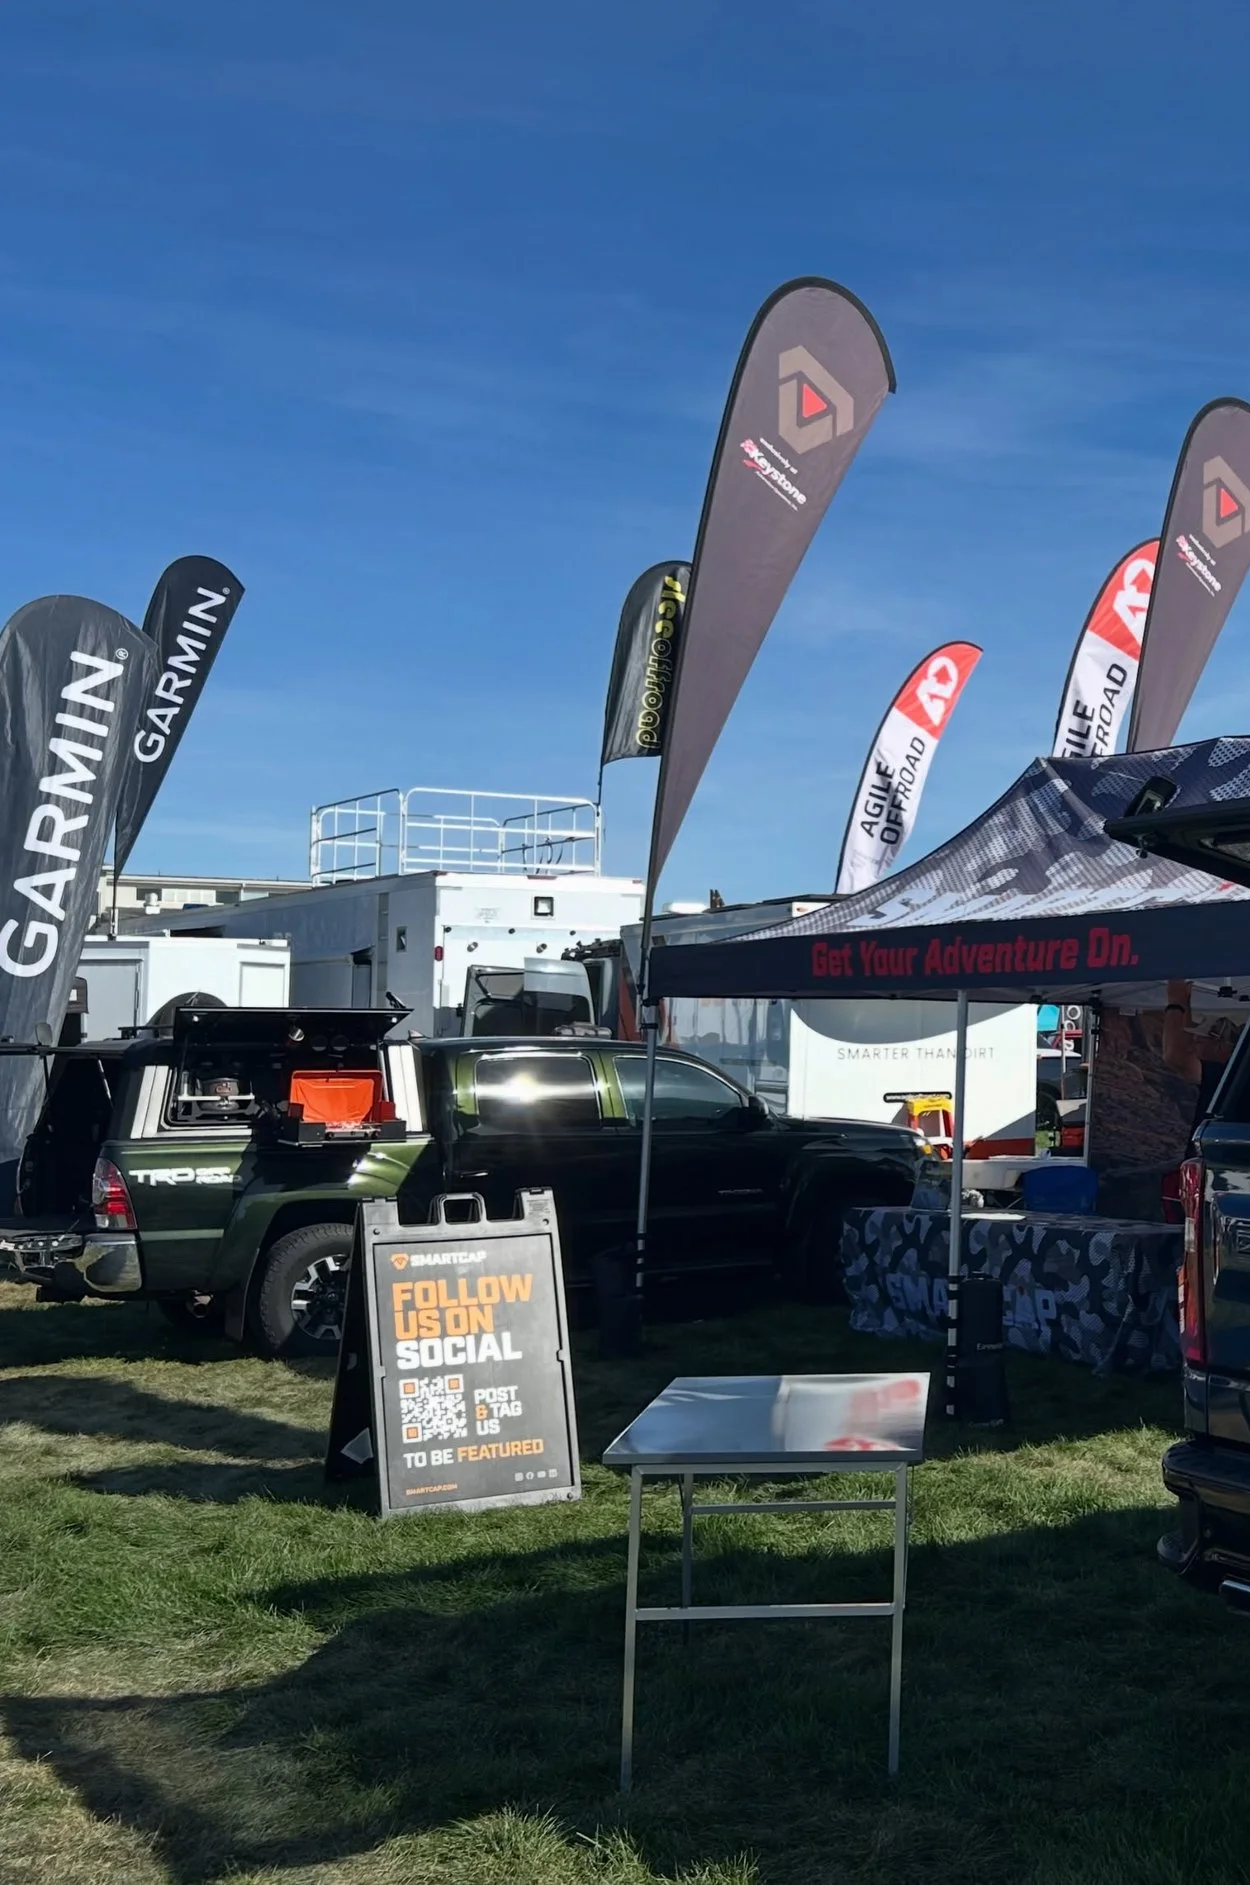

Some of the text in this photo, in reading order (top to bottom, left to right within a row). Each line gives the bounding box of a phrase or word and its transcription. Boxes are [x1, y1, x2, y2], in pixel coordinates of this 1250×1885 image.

[749, 449, 807, 505] Keystone
[1182, 545, 1221, 592] Keystone
[860, 760, 896, 838] AGILE
[880, 736, 926, 846] OFFROAD
[811, 927, 1140, 977] Get Your Adventure On.
[837, 1046, 996, 1060] SMARTER THAN DIRT
[128, 1167, 195, 1187] TRD
[410, 1250, 488, 1267] SMARTCAP
[392, 1273, 533, 1312] FOLLOW
[395, 1305, 495, 1340] US ON
[396, 1331, 523, 1370] SOCIAL
[473, 1385, 519, 1405] POST
[475, 1400, 523, 1420] & TAG
[475, 1419, 501, 1436] US
[403, 1438, 545, 1469] TO BE FEATURED
[405, 1483, 458, 1496] SMARTCAP.COM
